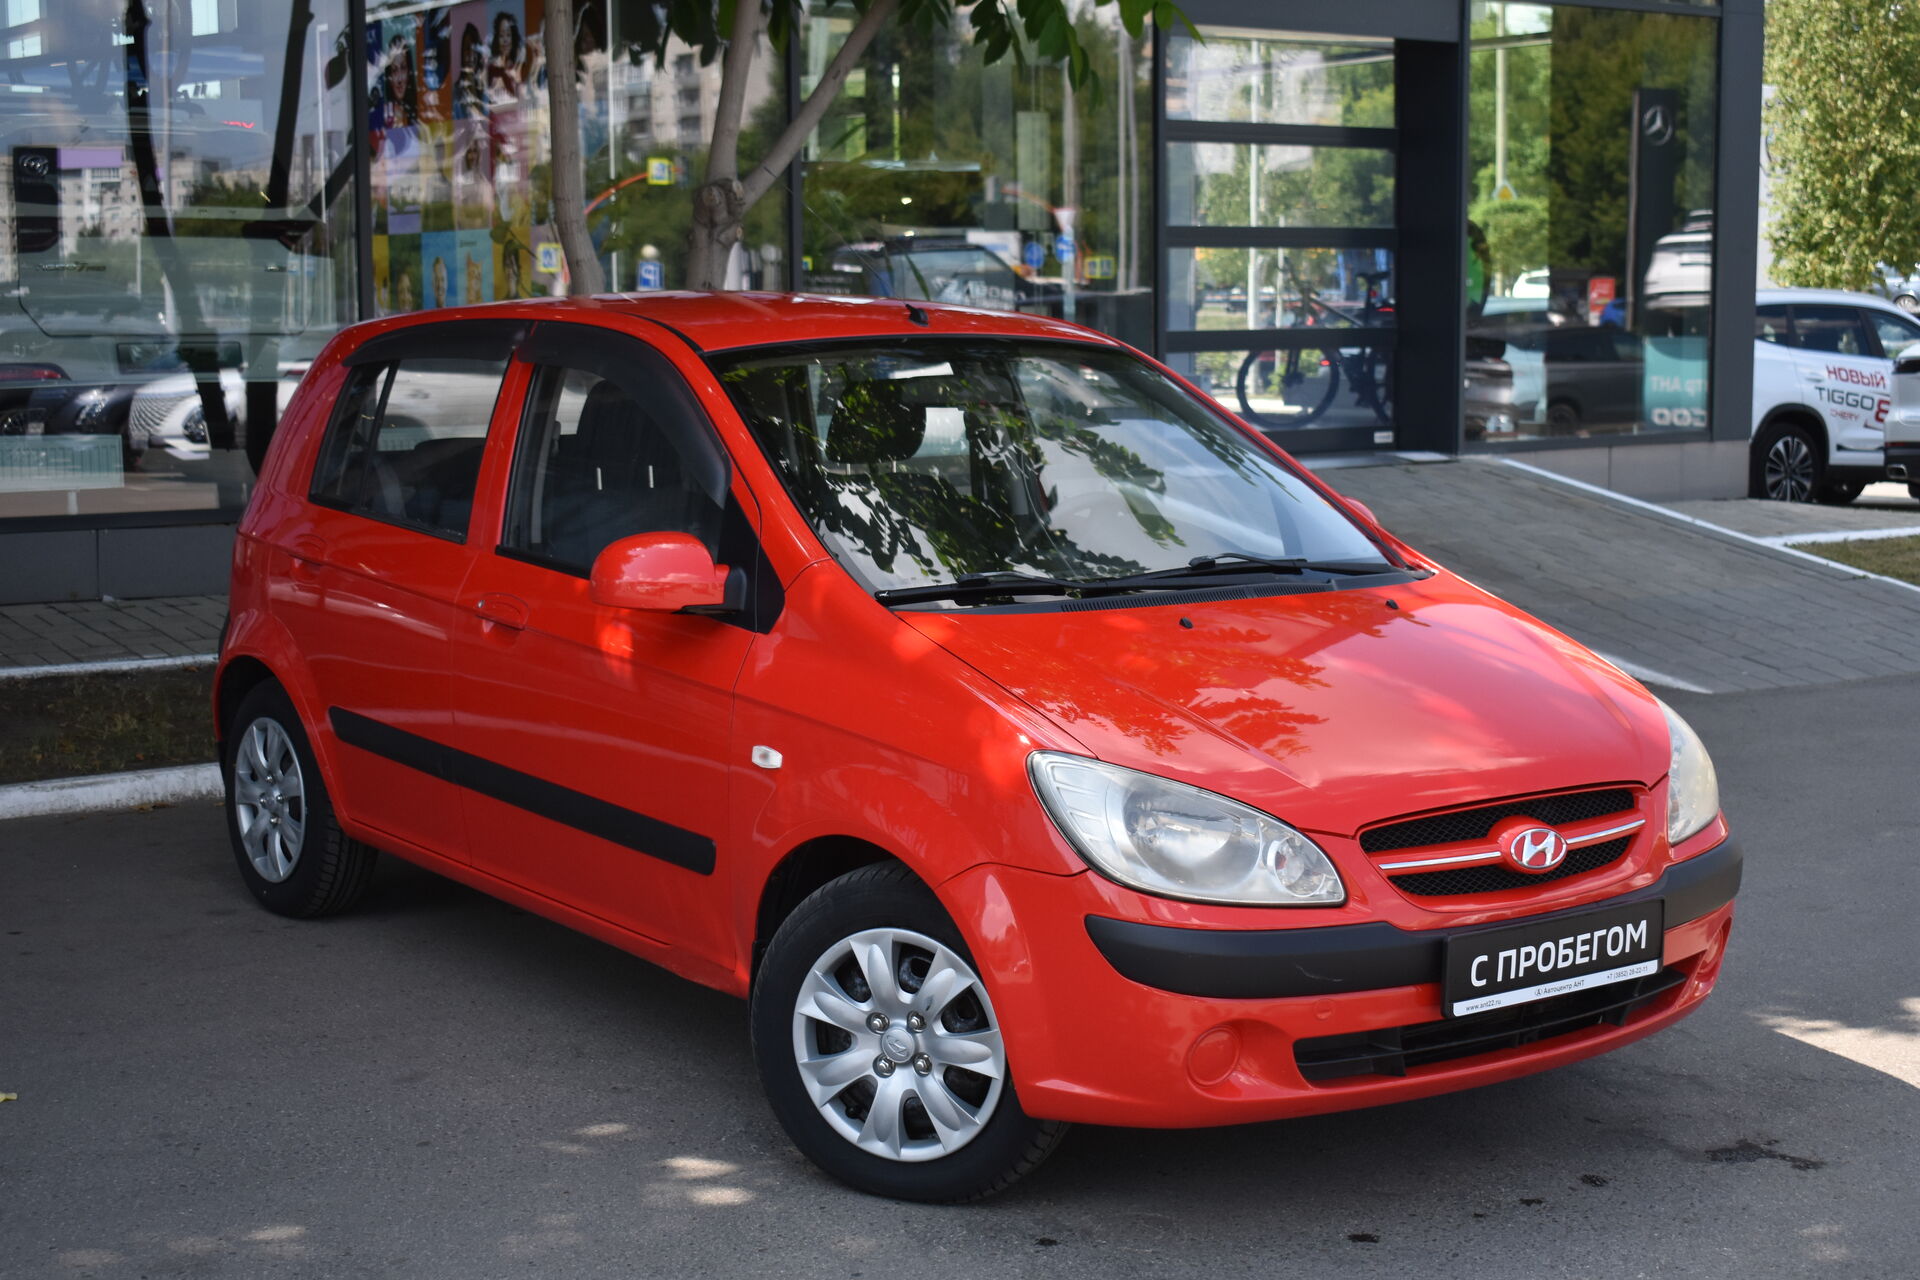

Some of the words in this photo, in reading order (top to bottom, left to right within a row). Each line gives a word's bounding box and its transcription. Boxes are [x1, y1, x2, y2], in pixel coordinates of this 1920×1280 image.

[1825, 364, 1887, 389] НОВЫЙ
[1470, 955, 1488, 987] С
[1496, 919, 1647, 982] ПРОБЕГОМ
[1543, 983, 1572, 995] Автоцентр
[1573, 979, 1585, 988] АНТ
[1465, 999, 1502, 1012] www.ant22.ru
